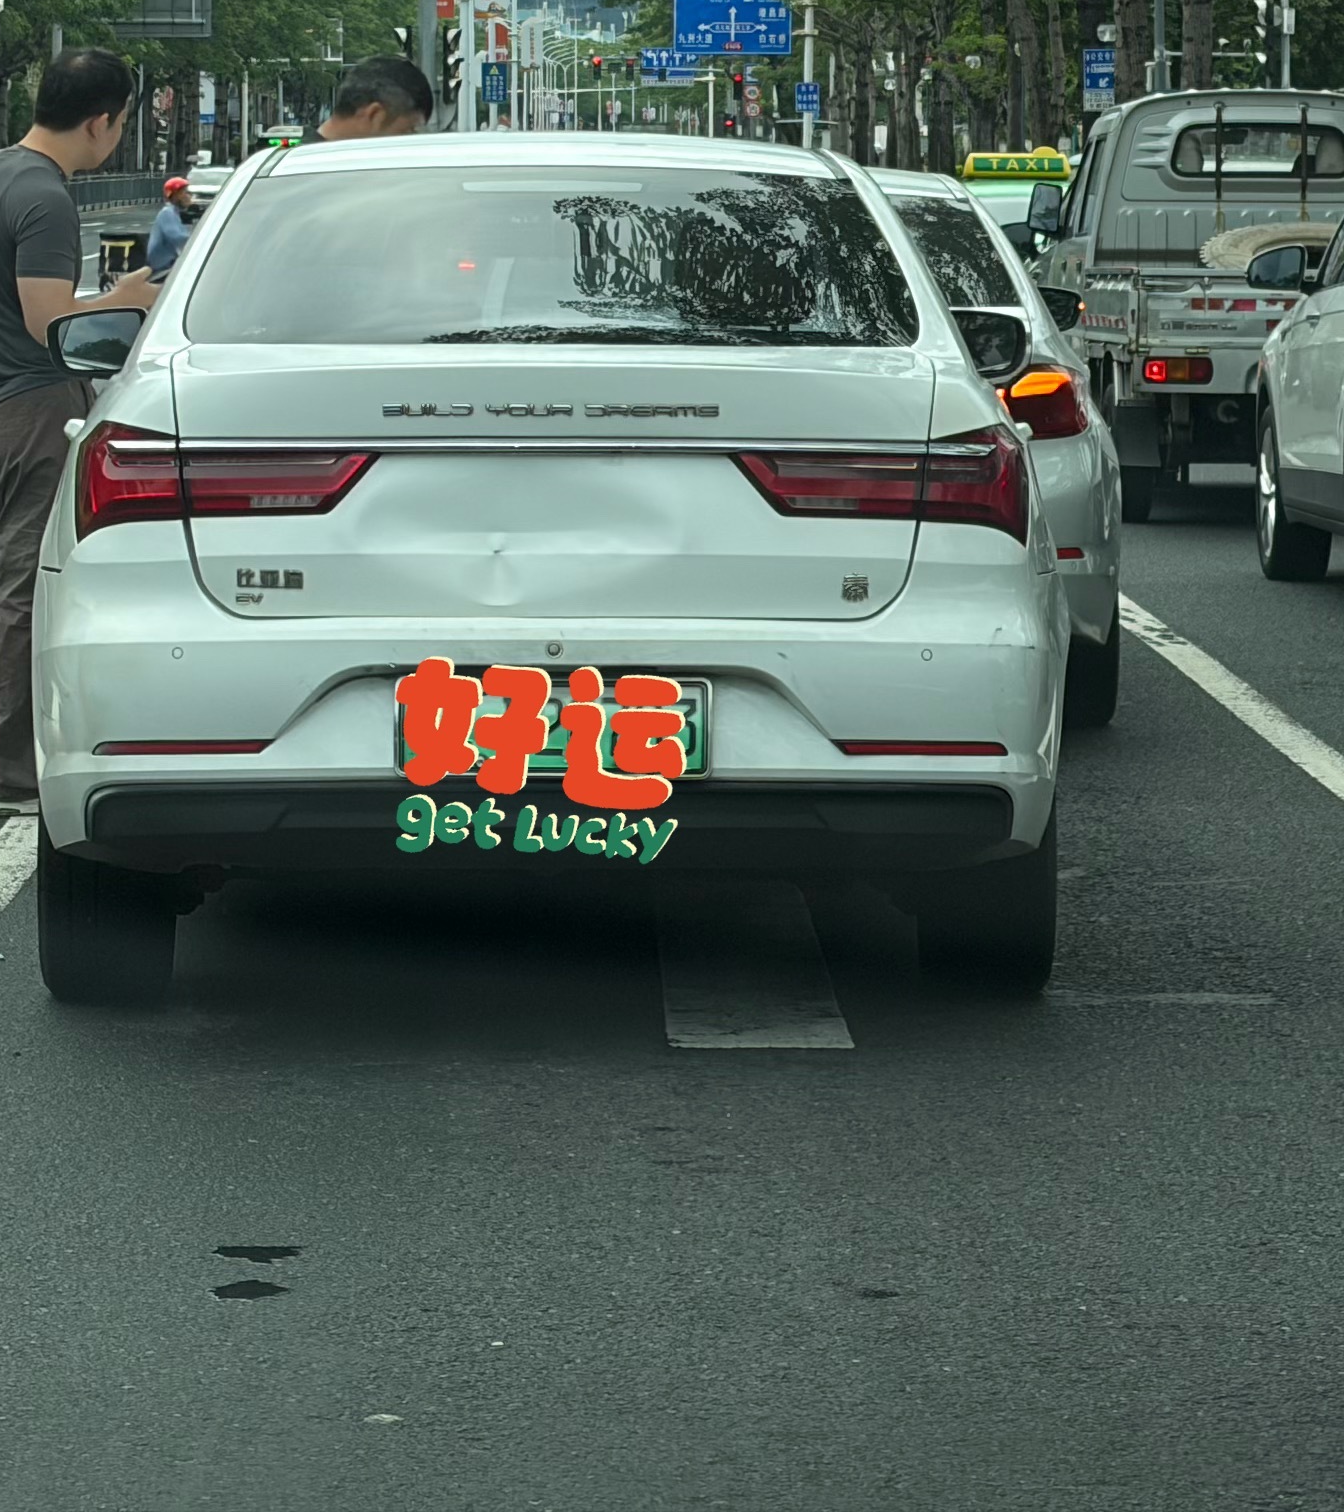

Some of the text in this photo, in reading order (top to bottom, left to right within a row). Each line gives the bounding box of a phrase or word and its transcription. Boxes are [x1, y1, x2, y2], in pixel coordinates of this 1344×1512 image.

[988, 158, 1050, 171] TAXI
[382, 402, 720, 418] BUILD YOUR DREAMS
[236, 568, 303, 589] 比亚迪
[235, 593, 264, 605] EV
